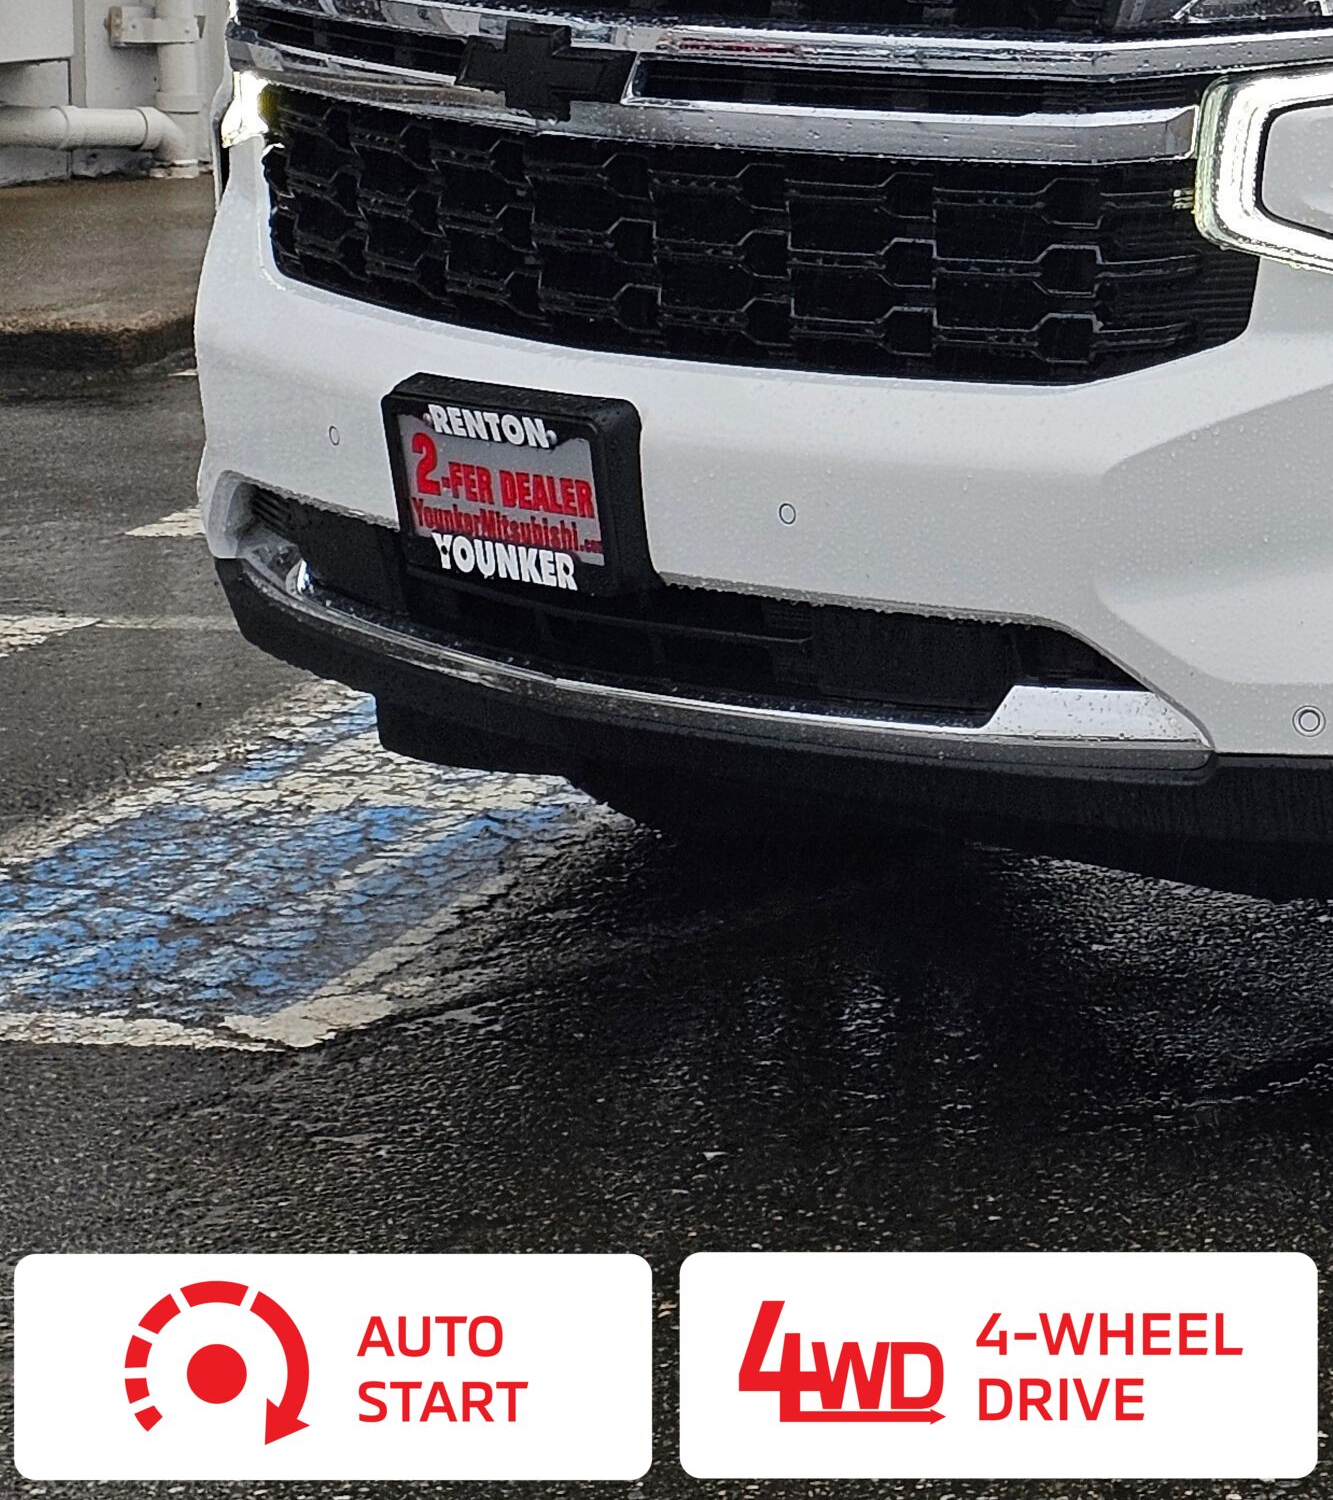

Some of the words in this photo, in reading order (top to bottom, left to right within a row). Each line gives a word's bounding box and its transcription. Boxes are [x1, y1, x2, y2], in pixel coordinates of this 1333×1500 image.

[427, 403, 551, 449] RENTON
[410, 431, 495, 506] 2-FER
[498, 469, 595, 520] DEALER
[431, 531, 579, 592] YOUNKER
